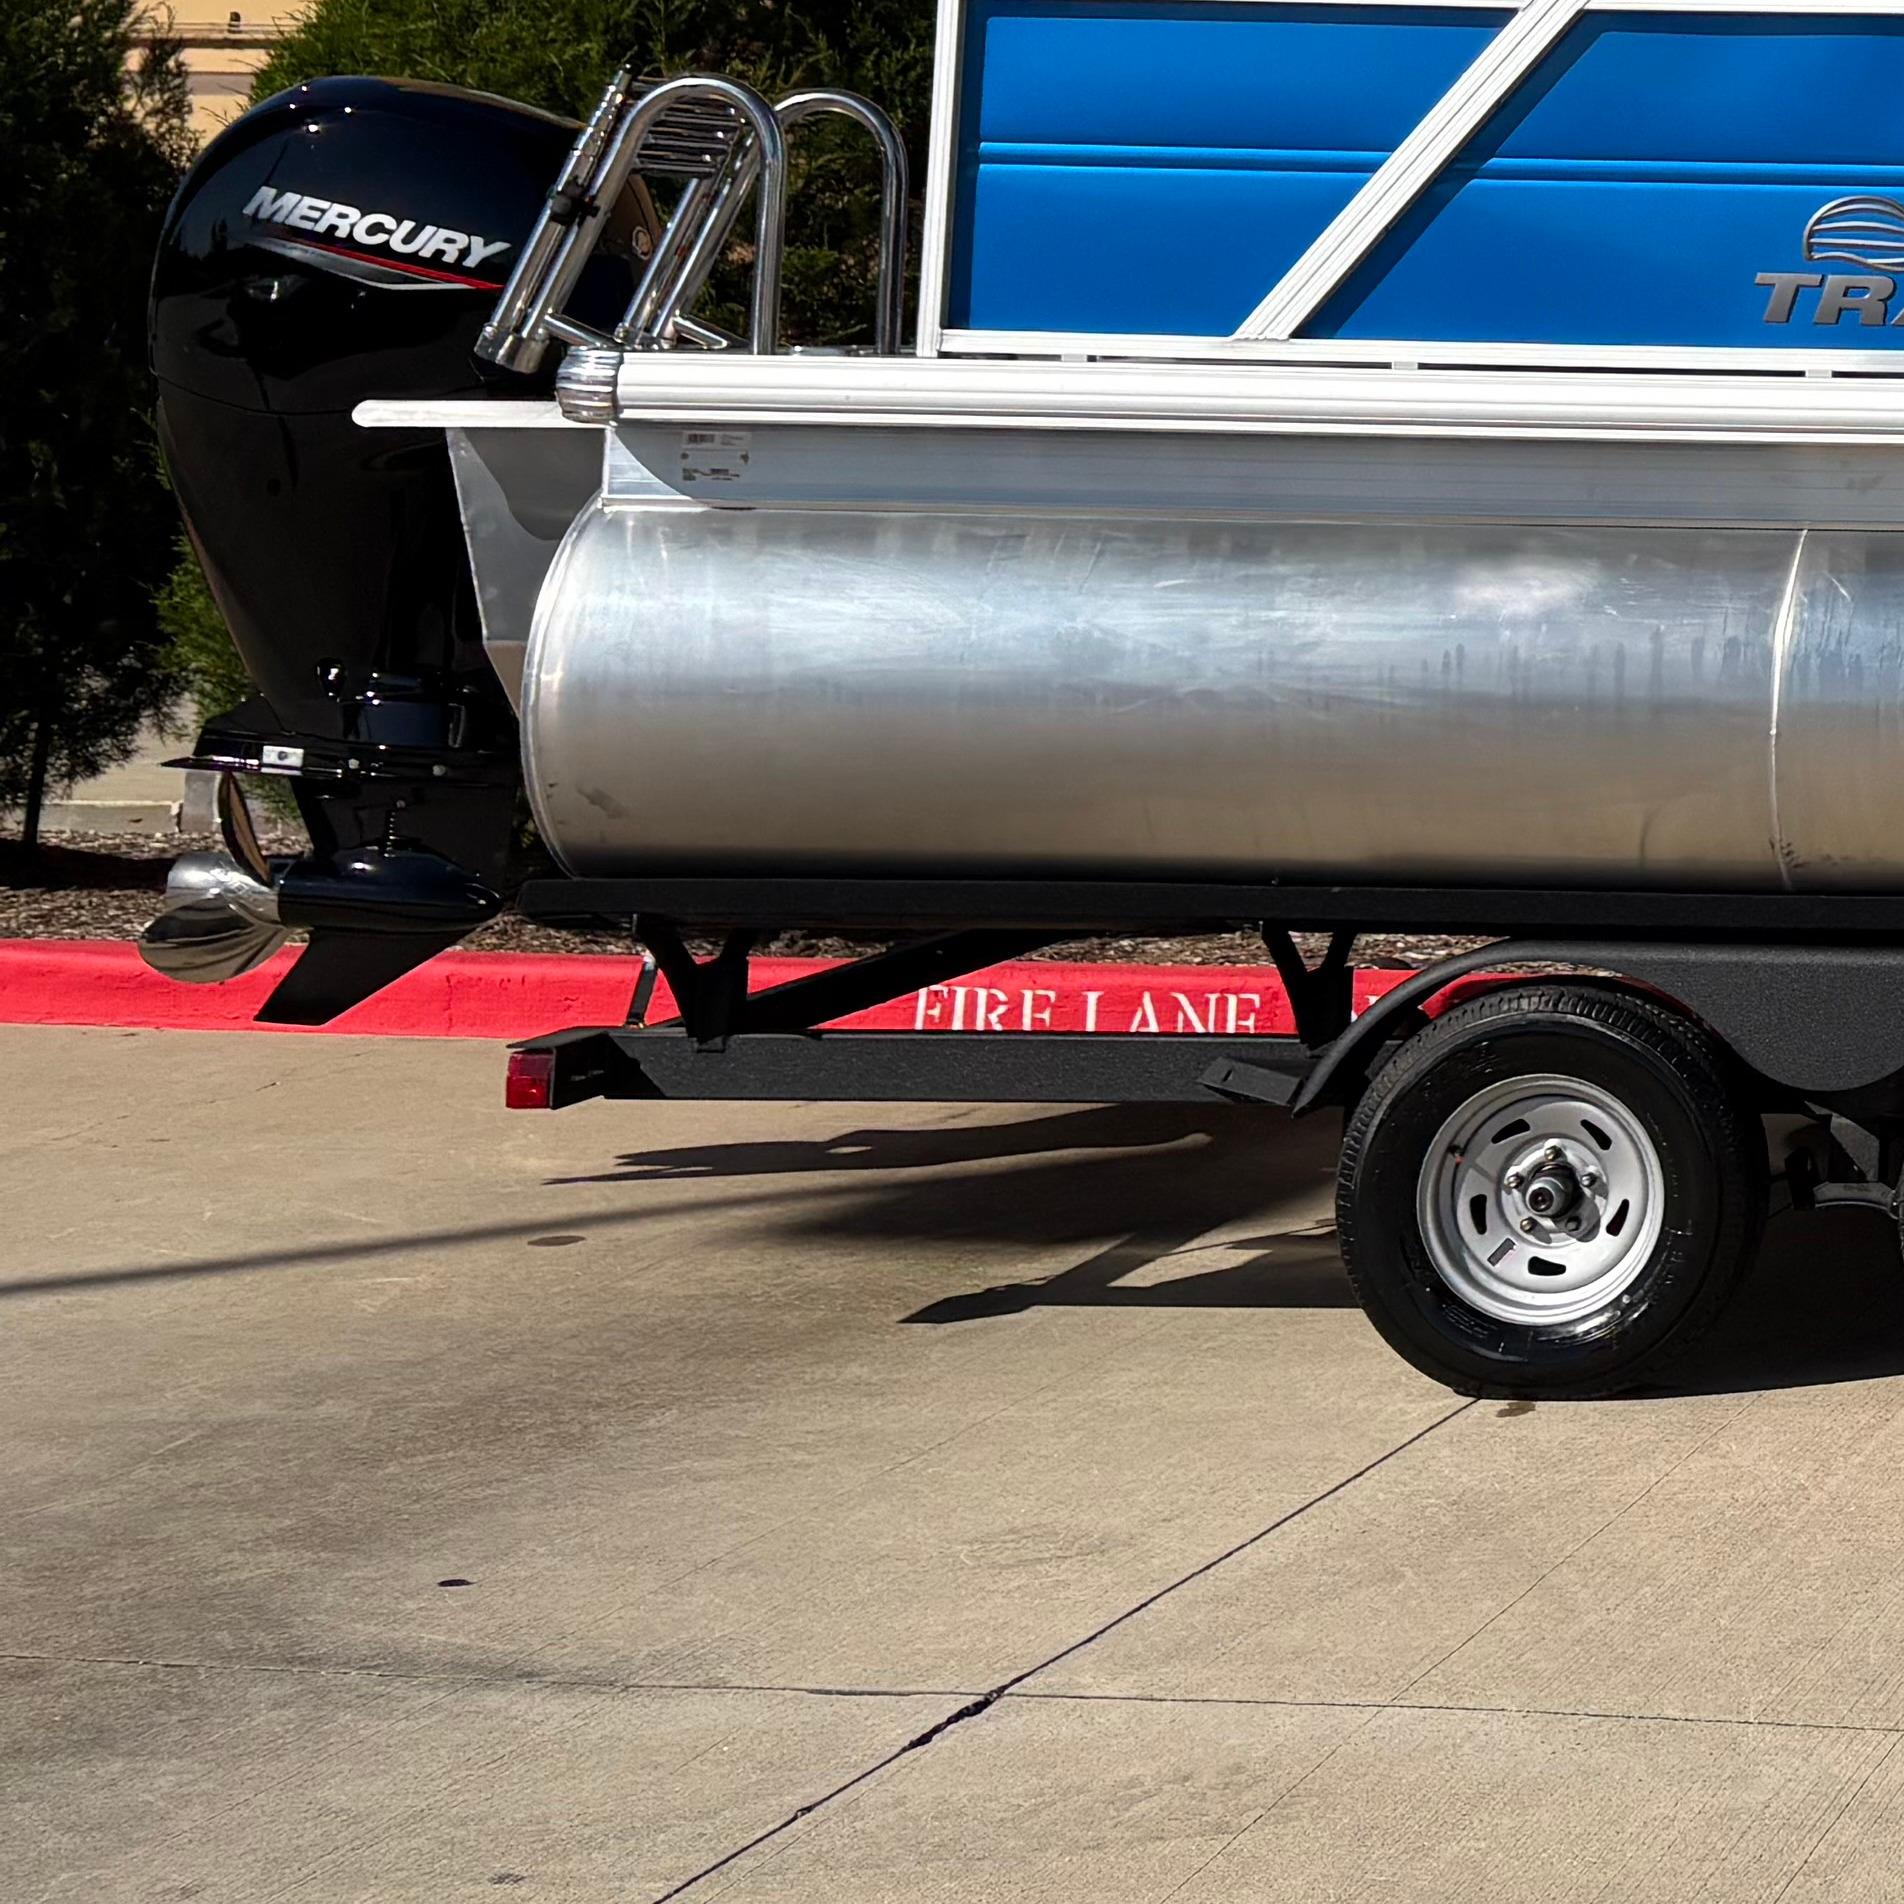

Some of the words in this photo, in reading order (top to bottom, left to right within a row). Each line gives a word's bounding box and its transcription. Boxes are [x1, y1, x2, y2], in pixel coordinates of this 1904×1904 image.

[242, 185, 512, 269] MERCURY
[914, 984, 1056, 1032] FIRE
[1081, 990, 1261, 1034] LANE
